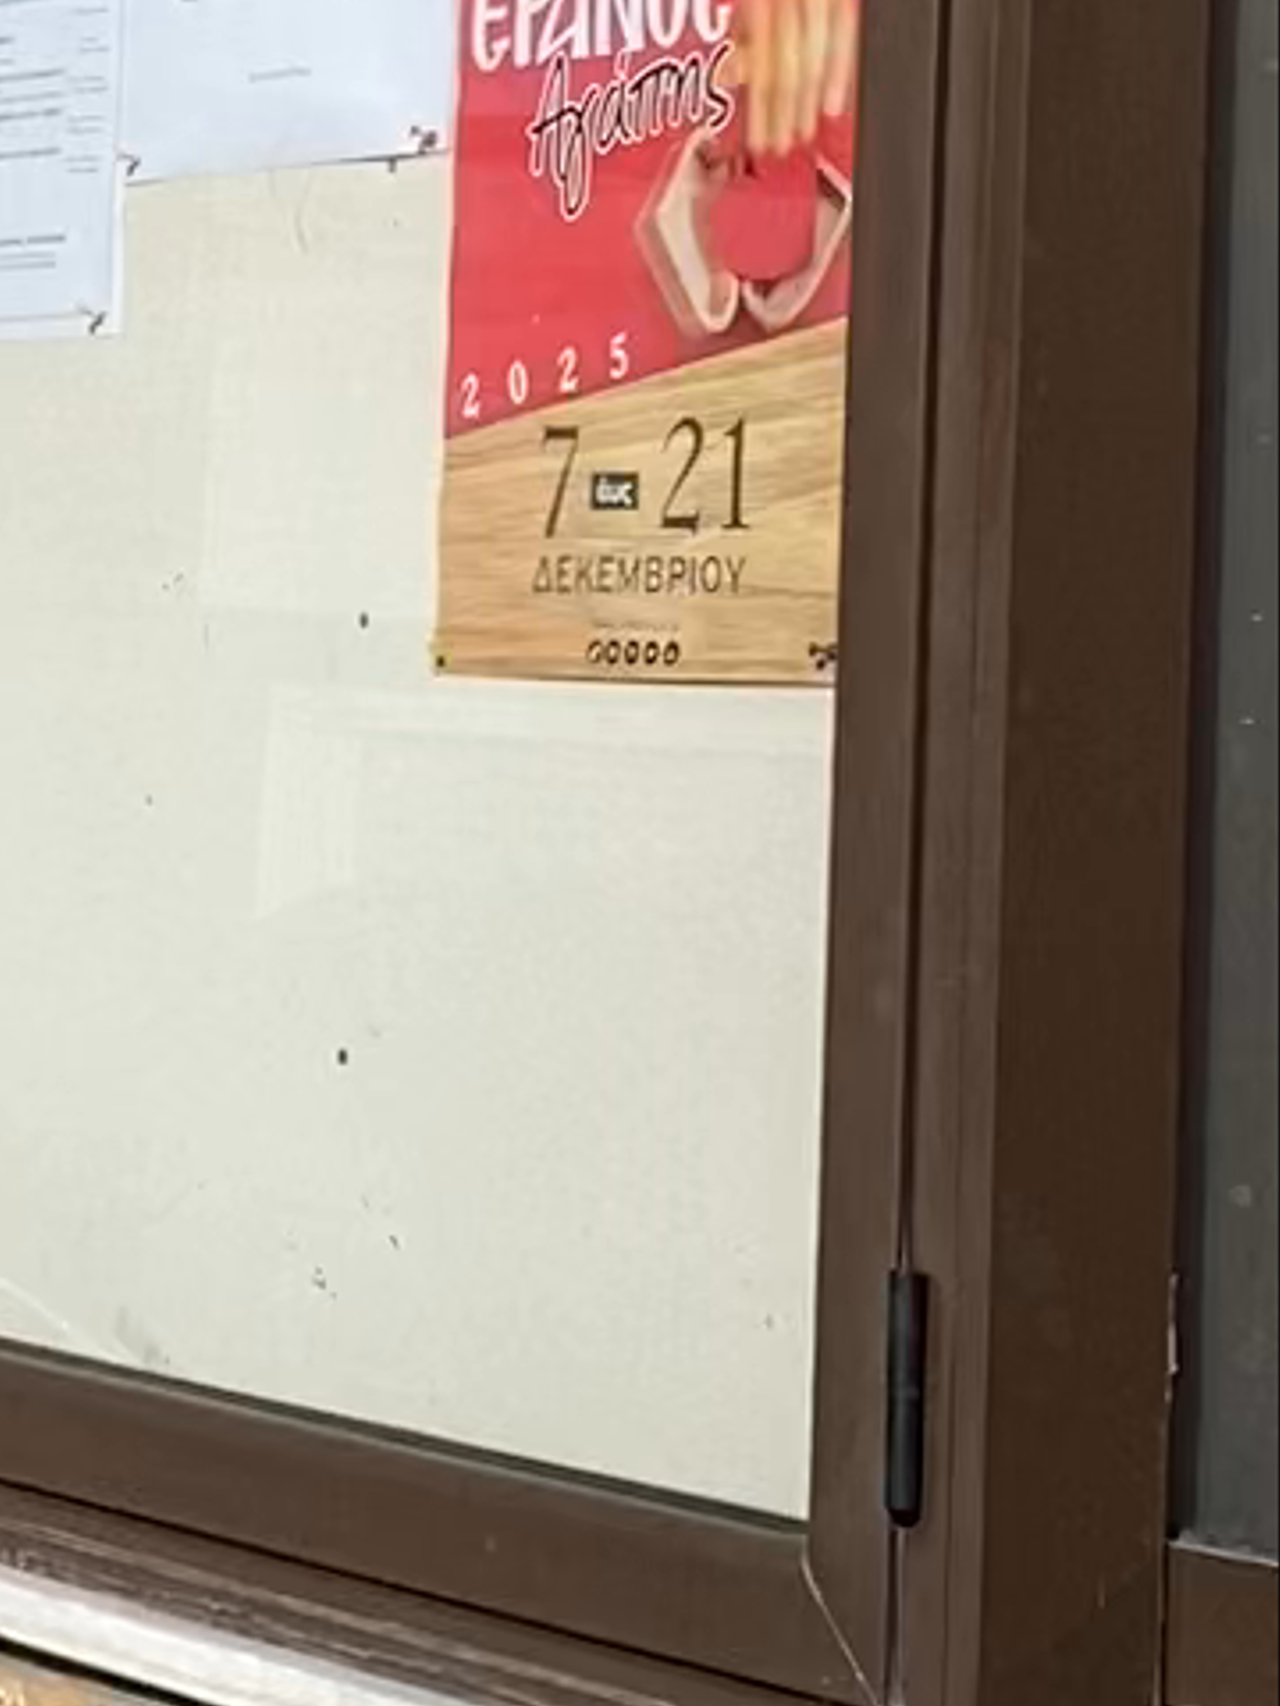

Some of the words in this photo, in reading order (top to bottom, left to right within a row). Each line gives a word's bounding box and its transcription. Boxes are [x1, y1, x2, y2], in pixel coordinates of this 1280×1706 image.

[541, 424, 580, 539] 7
[659, 416, 752, 534] 21
[532, 553, 748, 595] ΔΕΚΕΜΒΡΙΟΥ
